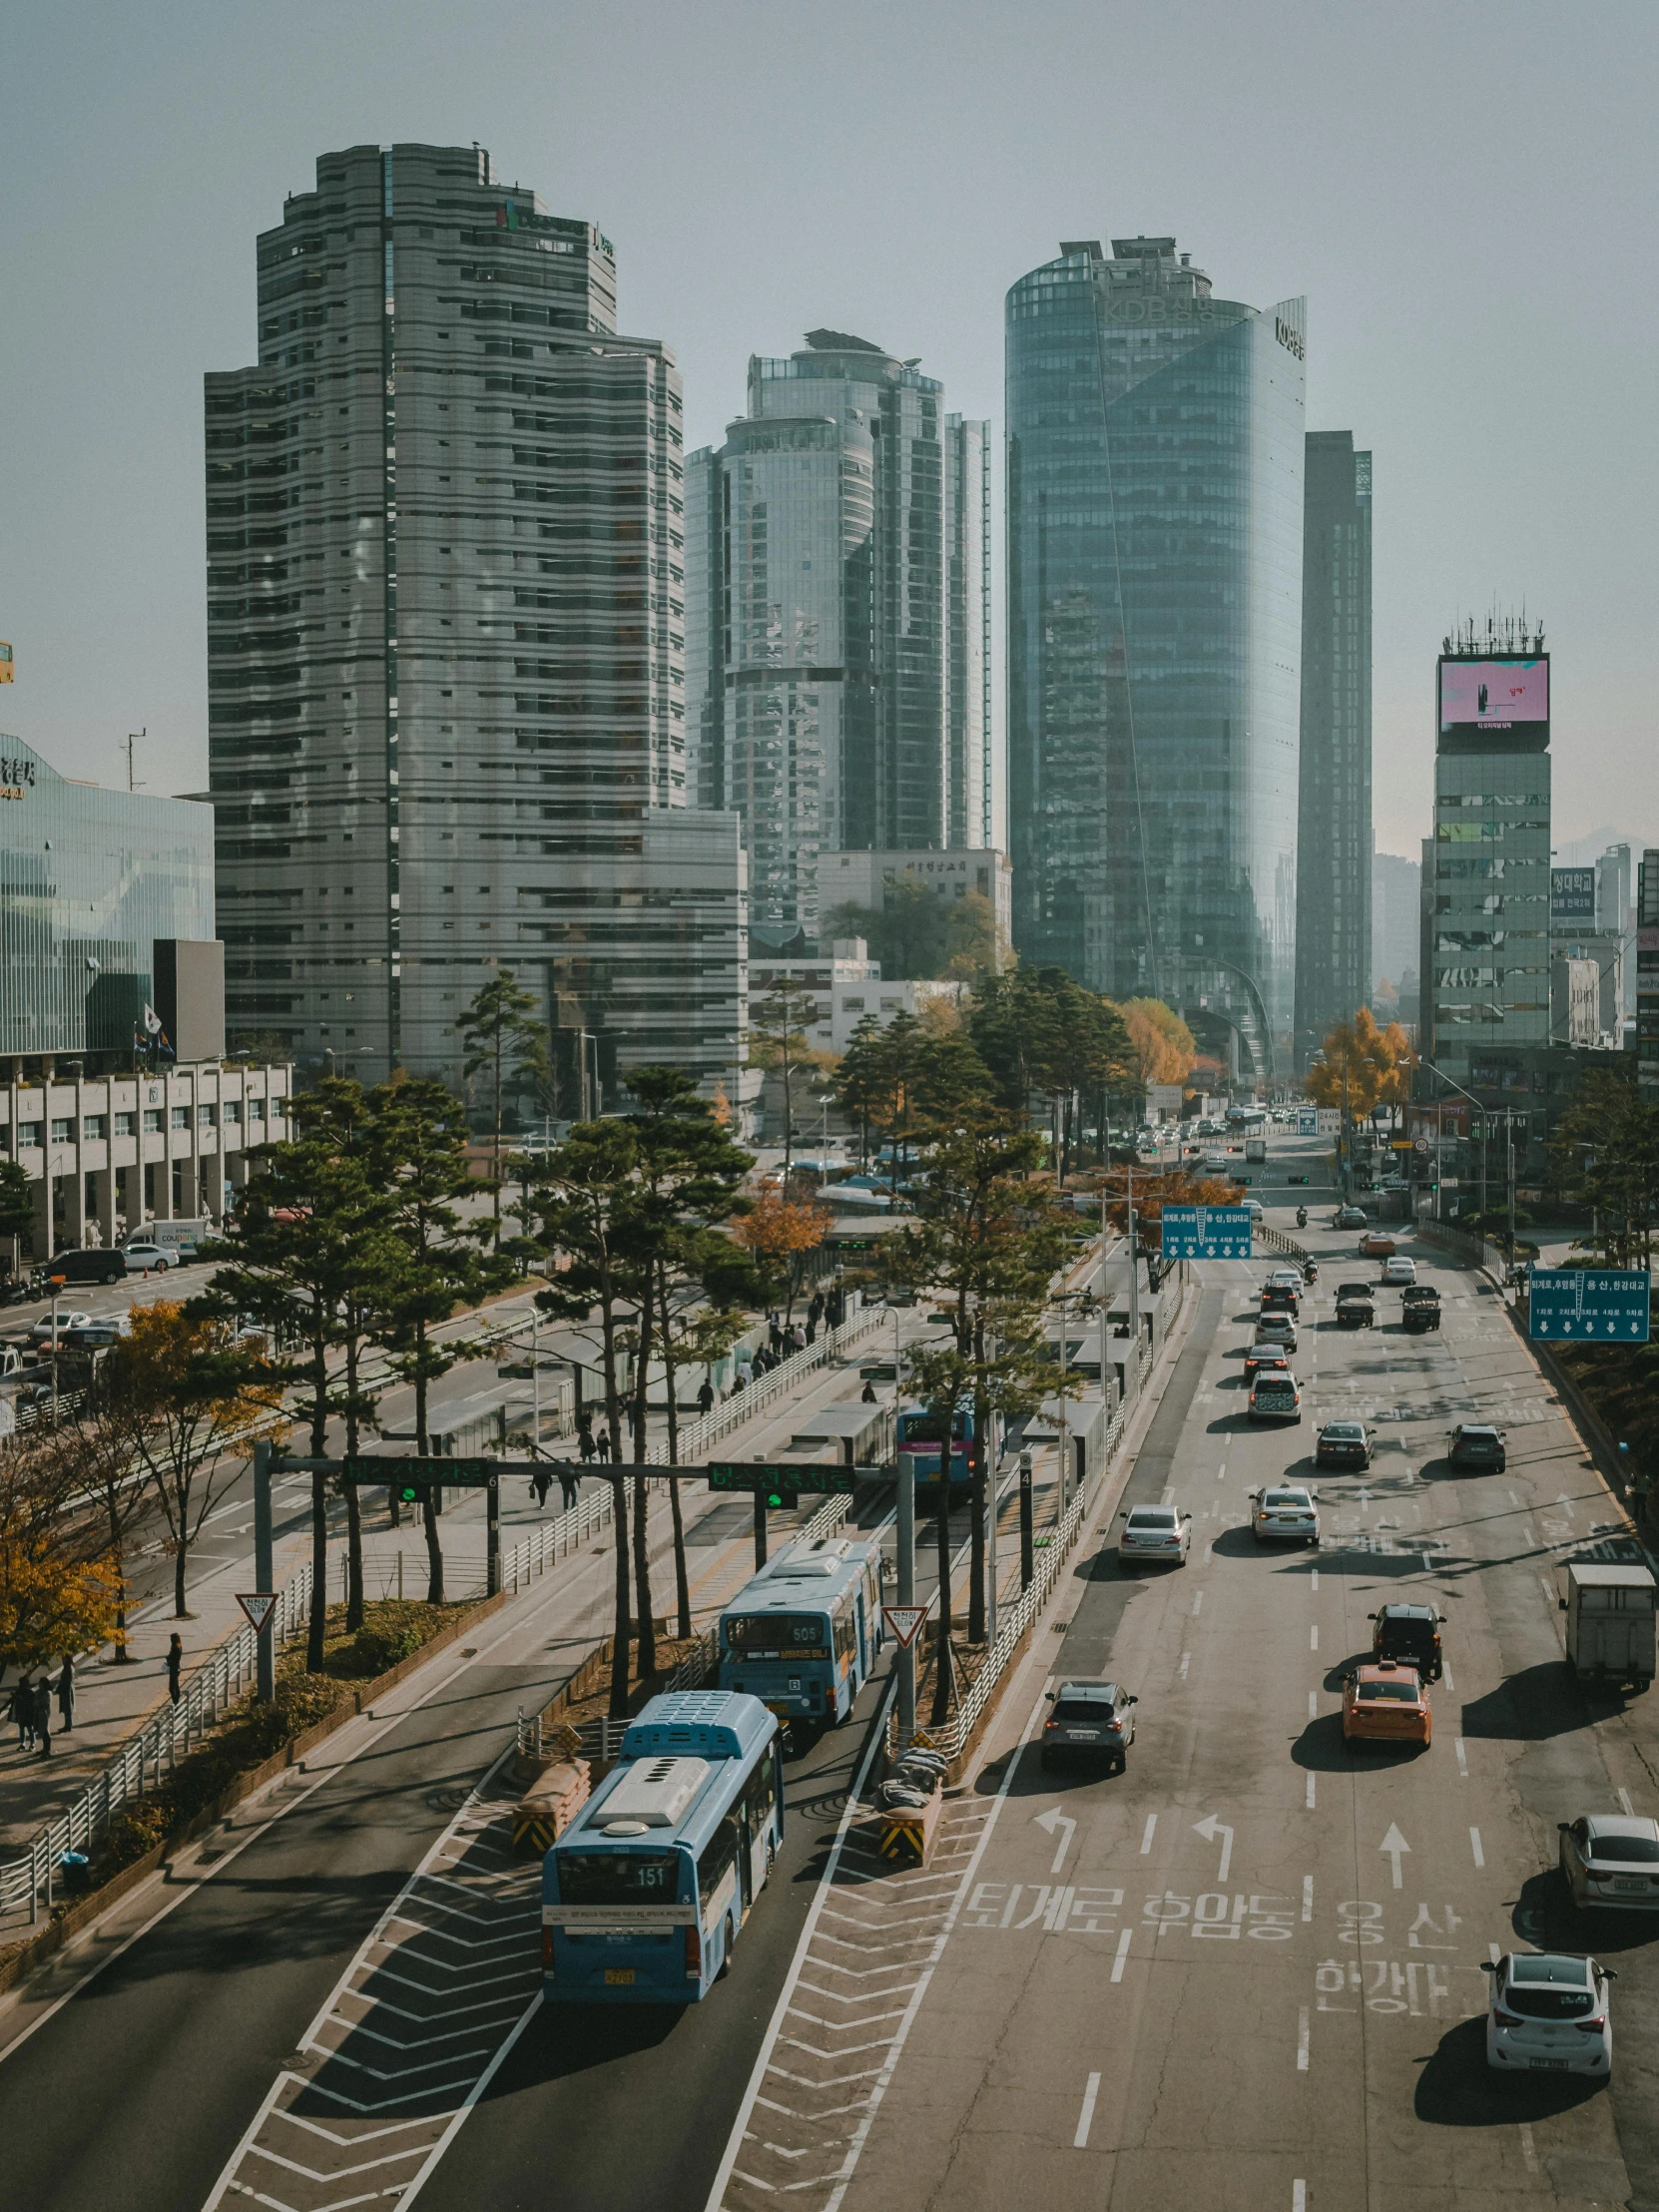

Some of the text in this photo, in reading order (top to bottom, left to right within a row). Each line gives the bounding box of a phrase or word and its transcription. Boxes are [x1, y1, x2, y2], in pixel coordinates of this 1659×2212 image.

[162, 1234, 198, 1243] coupang
[489, 1475, 497, 1487] 6
[1021, 1473, 1030, 1484] 4
[794, 1628, 817, 1641] 505
[638, 1868, 665, 1886] 151
[963, 1882, 1124, 1933] 퇴계로
[1143, 1891, 1293, 1940] 후암동
